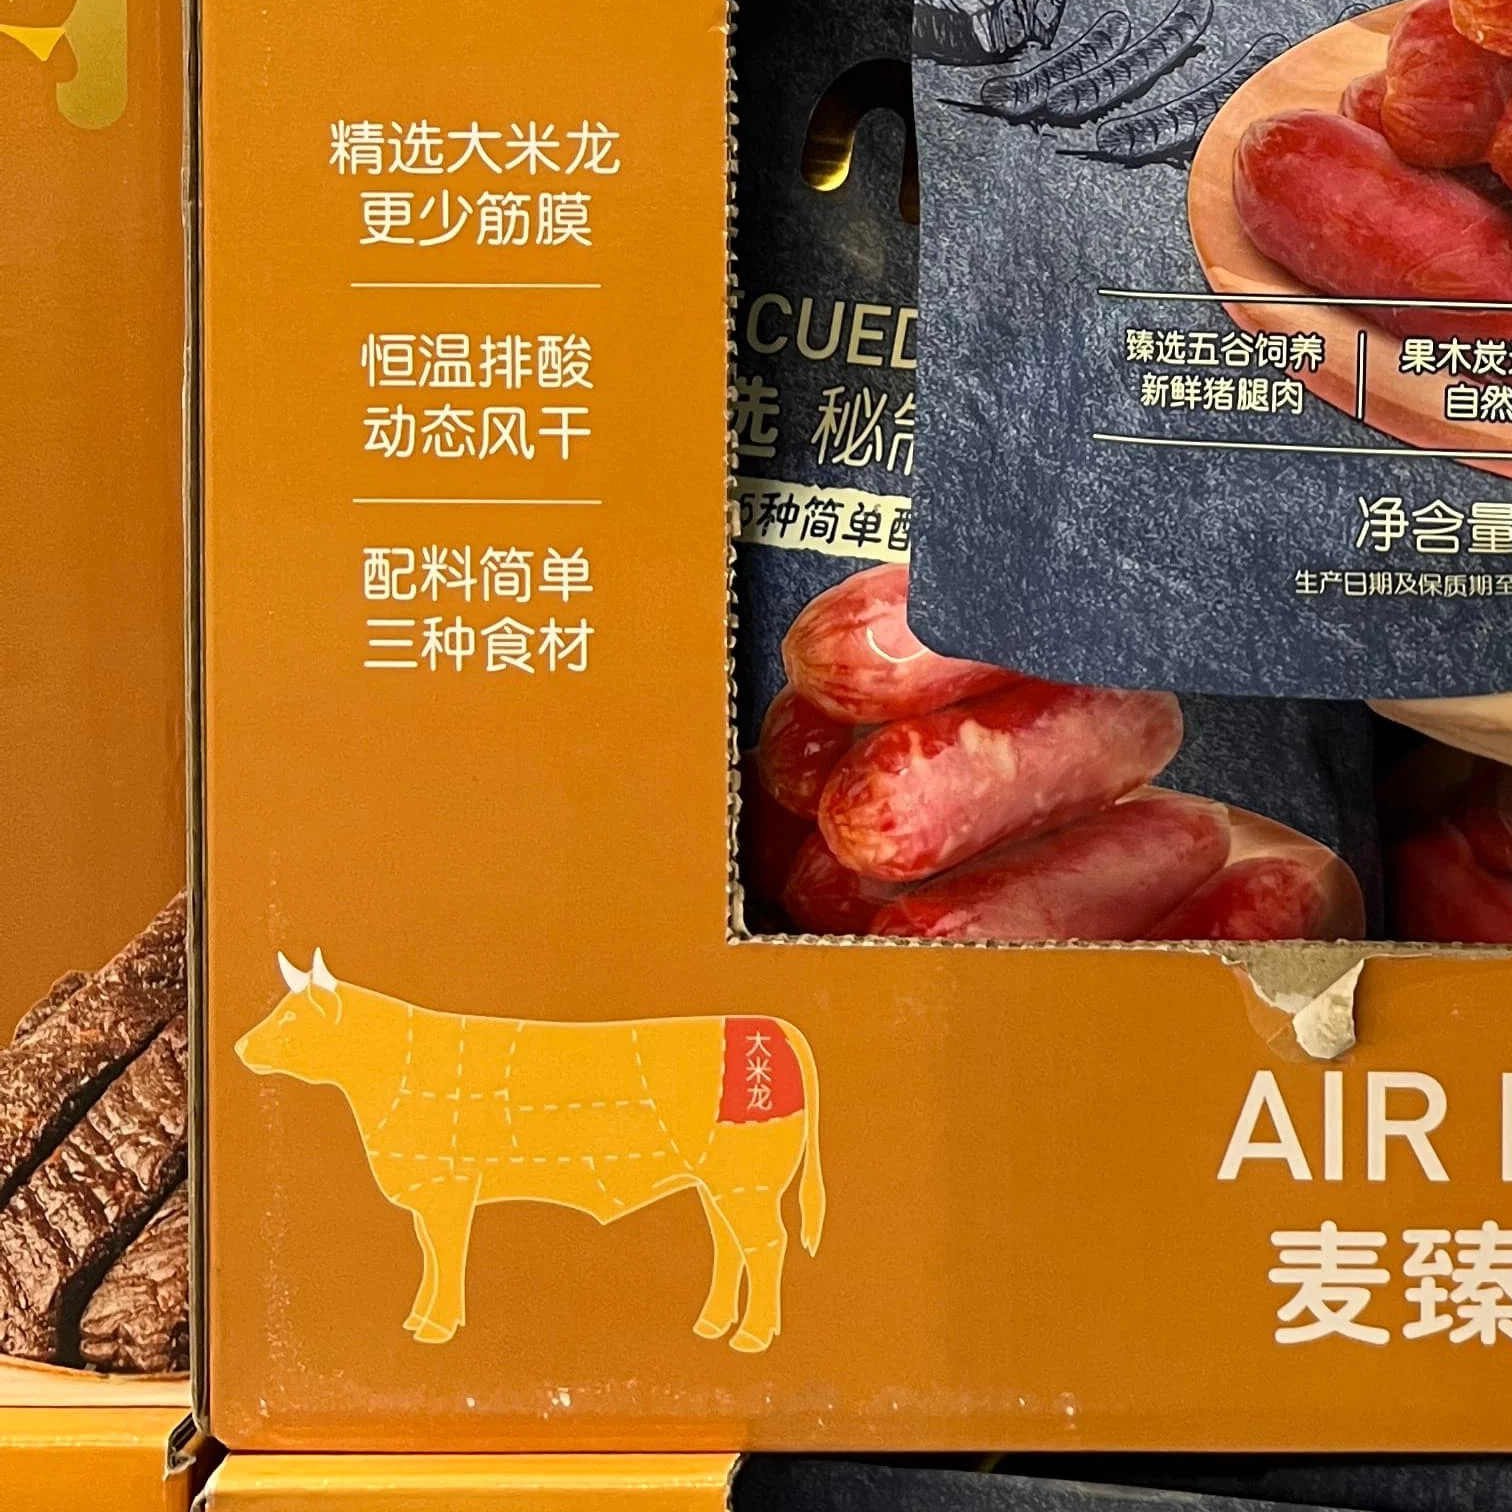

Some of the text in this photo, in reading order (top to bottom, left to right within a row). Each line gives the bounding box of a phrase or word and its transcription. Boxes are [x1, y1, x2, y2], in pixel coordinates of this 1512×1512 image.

[328, 119, 622, 176] 精选大米龙
[359, 191, 592, 248] 更少筋膜
[737, 291, 917, 369] CUED
[1125, 329, 1325, 371] 臻选五谷饲养
[360, 333, 594, 391] 恒温排酸
[1140, 373, 1303, 415] 新鲜猪腿肉
[362, 404, 592, 461] 动态风干
[362, 545, 594, 603] 配料简单
[363, 617, 594, 673] 三种食材
[745, 1031, 773, 1112] 大米龙
[1217, 1070, 1449, 1182] AIR
